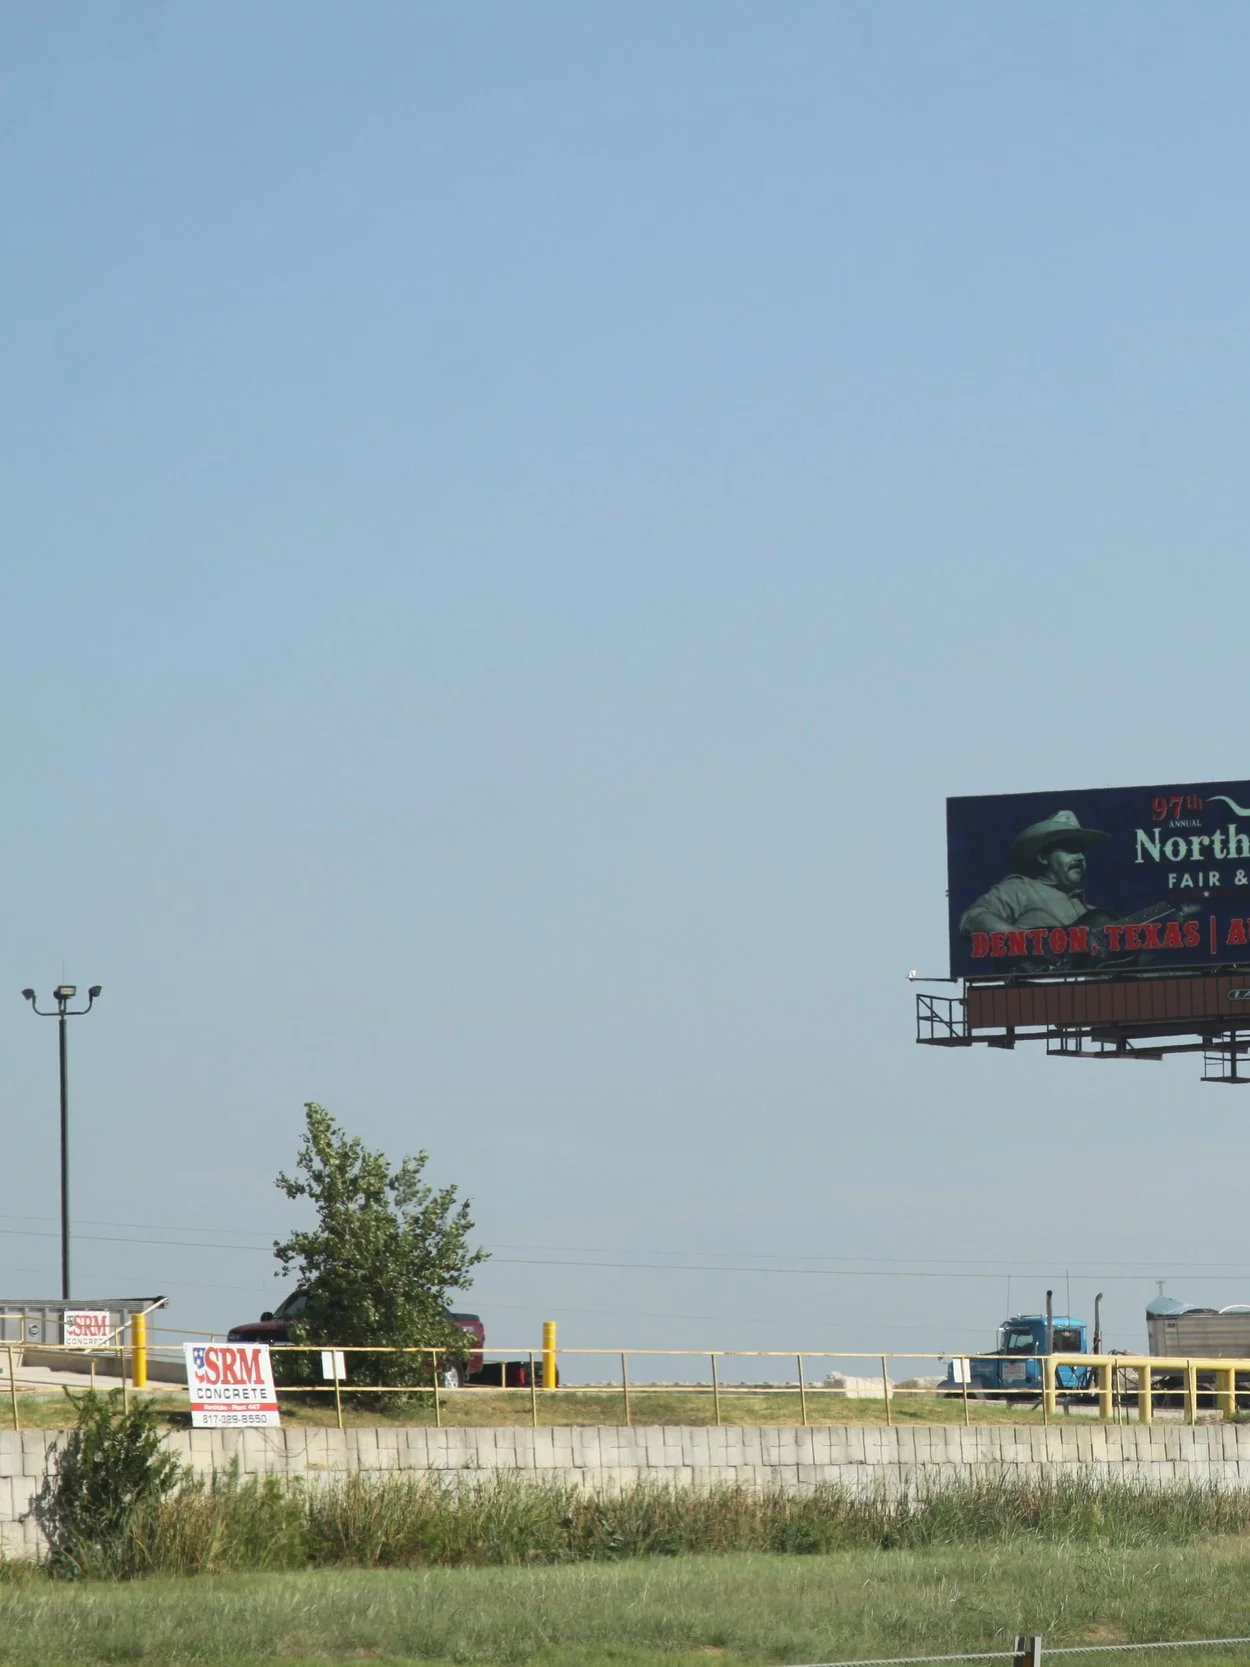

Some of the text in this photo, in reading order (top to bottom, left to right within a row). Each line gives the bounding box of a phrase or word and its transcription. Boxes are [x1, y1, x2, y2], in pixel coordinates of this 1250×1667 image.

[1151, 794, 1204, 821] 97th
[1169, 819, 1202, 828] ANNUAL
[1168, 870, 1221, 889] FAIR
[1234, 869, 1249, 885] &
[970, 925, 1099, 958] DENTON,
[1104, 920, 1201, 952] TEXAS
[73, 1315, 107, 1337] SRM
[204, 1346, 265, 1386] SRM
[197, 1388, 268, 1399] CONCRETE
